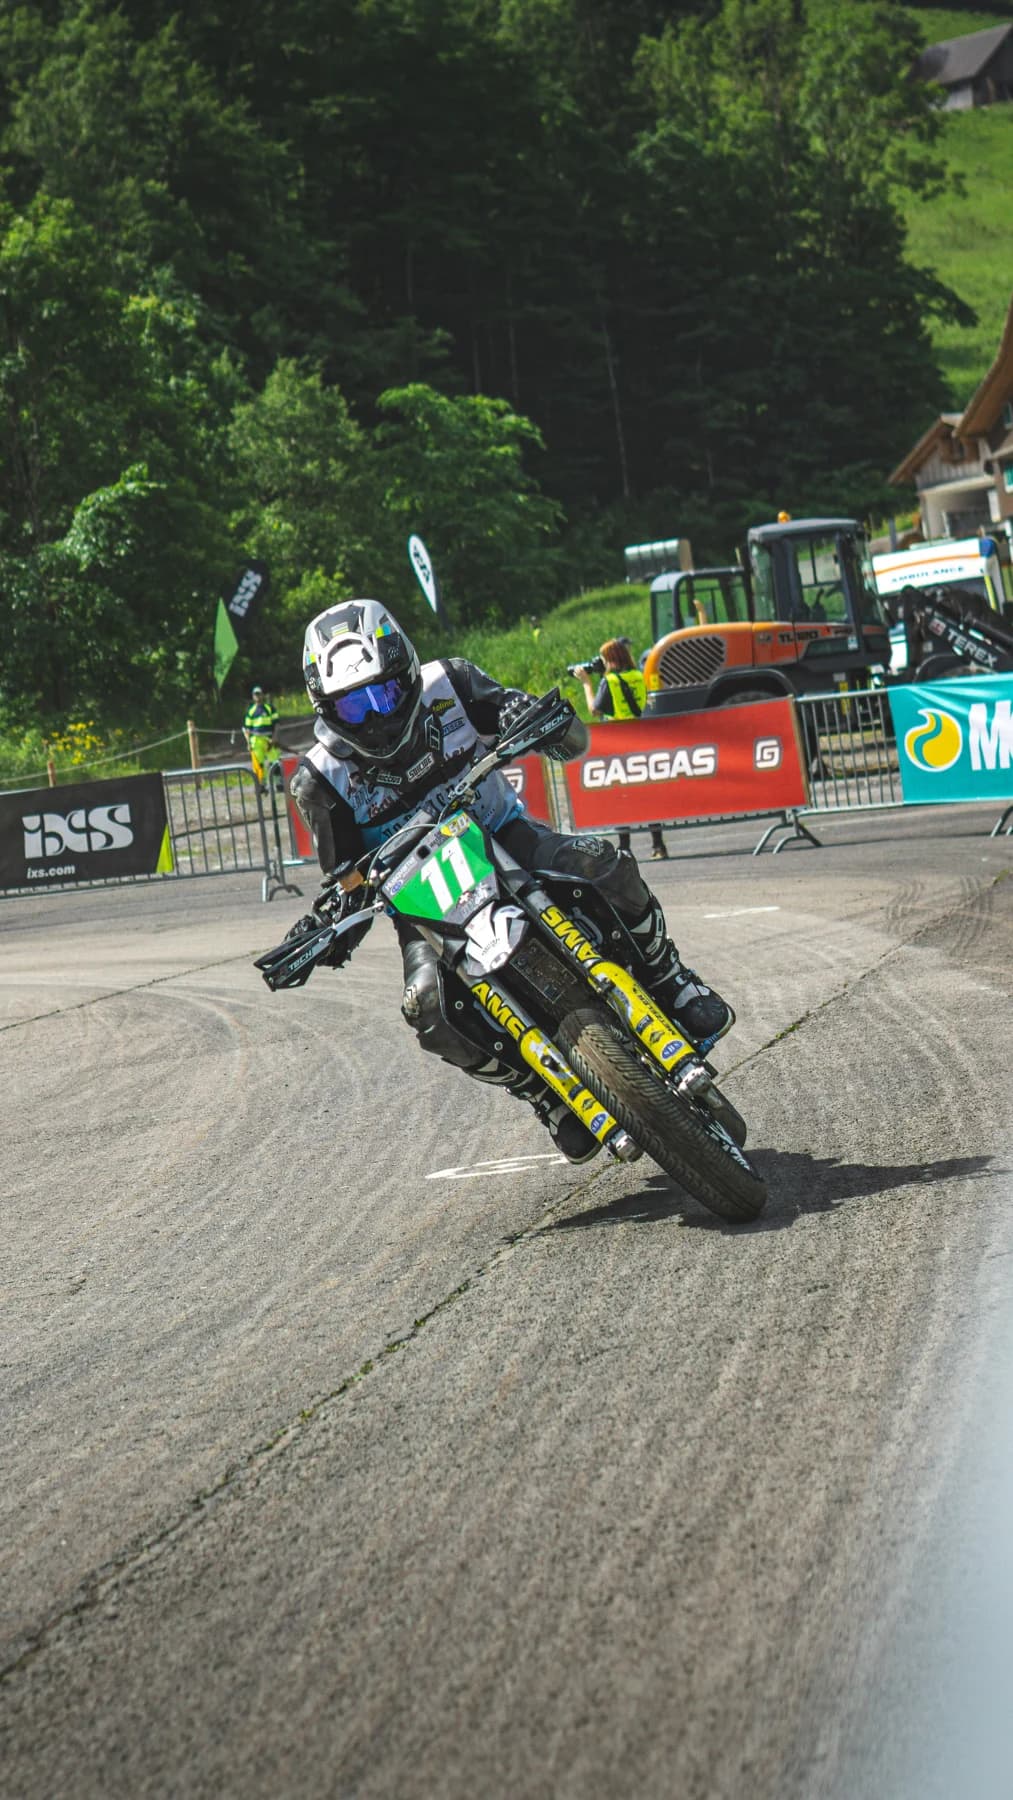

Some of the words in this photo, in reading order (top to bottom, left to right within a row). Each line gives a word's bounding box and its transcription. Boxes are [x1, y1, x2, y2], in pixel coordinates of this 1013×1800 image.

[891, 565, 965, 584] AMBULANCE
[946, 627, 999, 669] TEREX
[540, 714, 563, 733] TECH
[968, 700, 1013, 771] M
[583, 747, 716, 788] GASGAS
[27, 865, 76, 879] ixs.com
[420, 837, 476, 914] 11
[540, 905, 601, 962] AMS
[288, 949, 313, 971] TECH
[472, 981, 525, 1041] AMS
